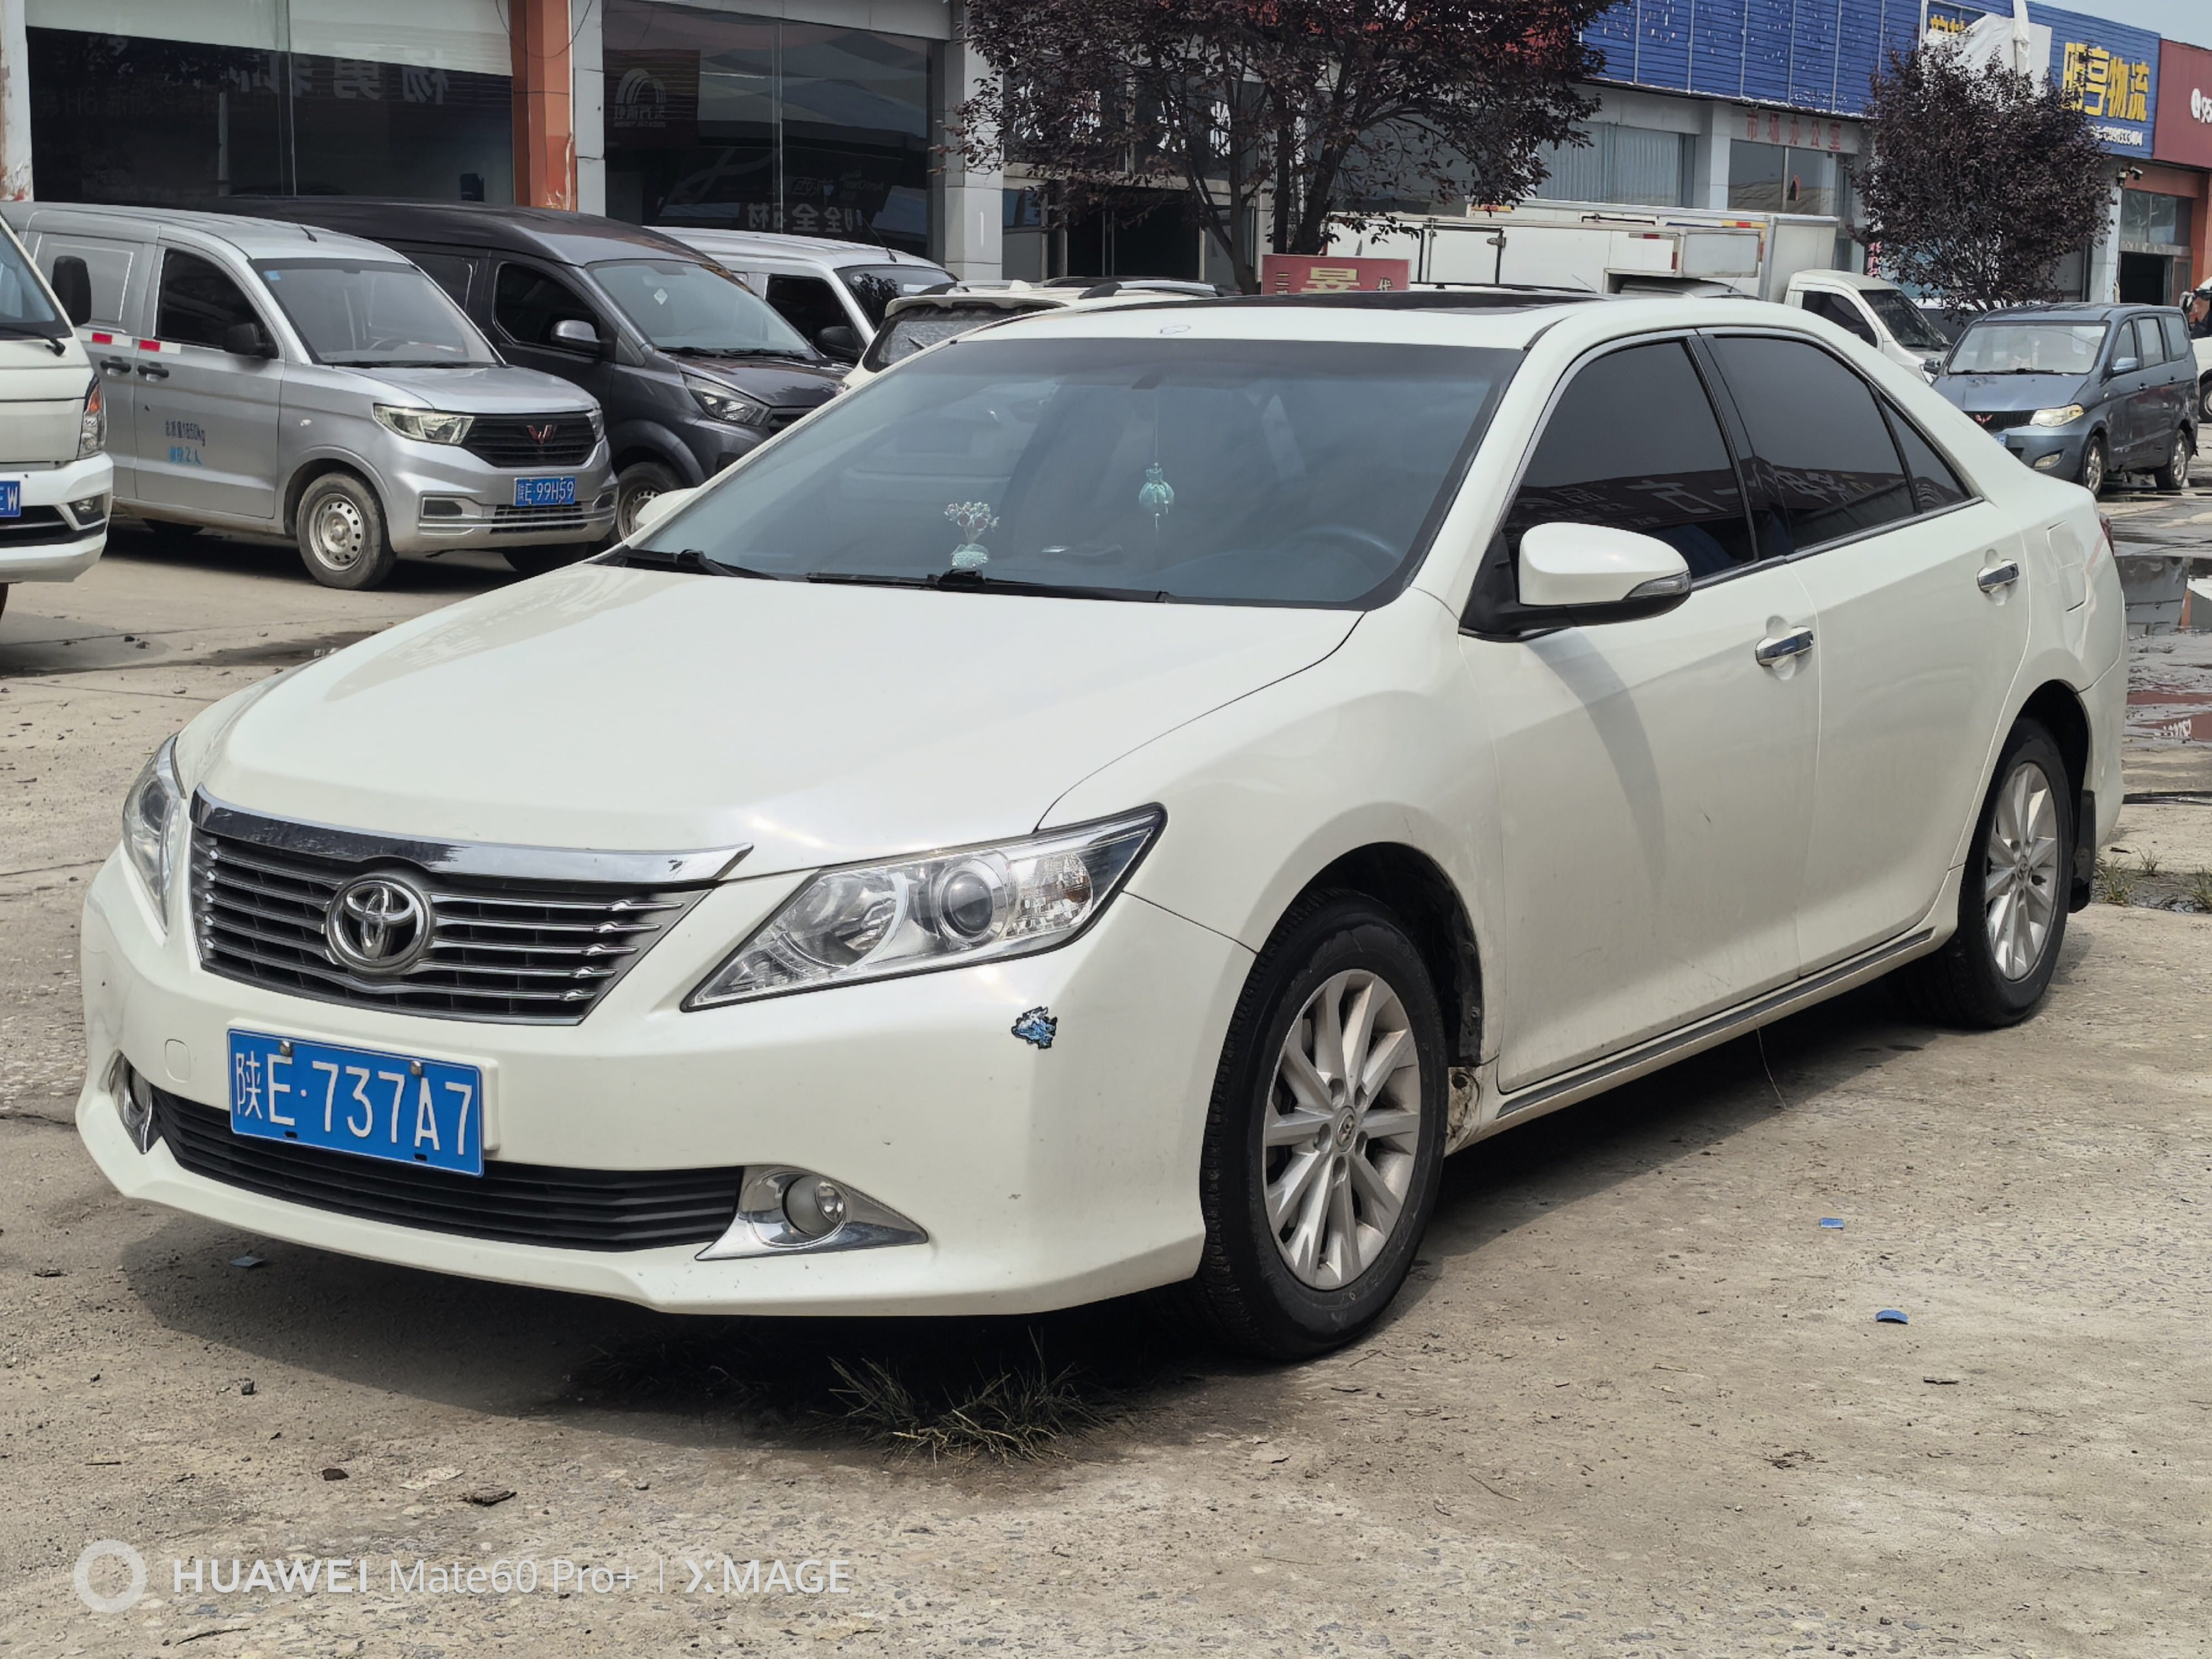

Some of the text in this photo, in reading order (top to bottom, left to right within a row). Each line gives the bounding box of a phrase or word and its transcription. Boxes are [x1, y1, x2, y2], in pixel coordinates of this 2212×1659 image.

[1746, 109, 1841, 151] 市场办公室
[236, 1050, 473, 1155] 陕E·737A7
